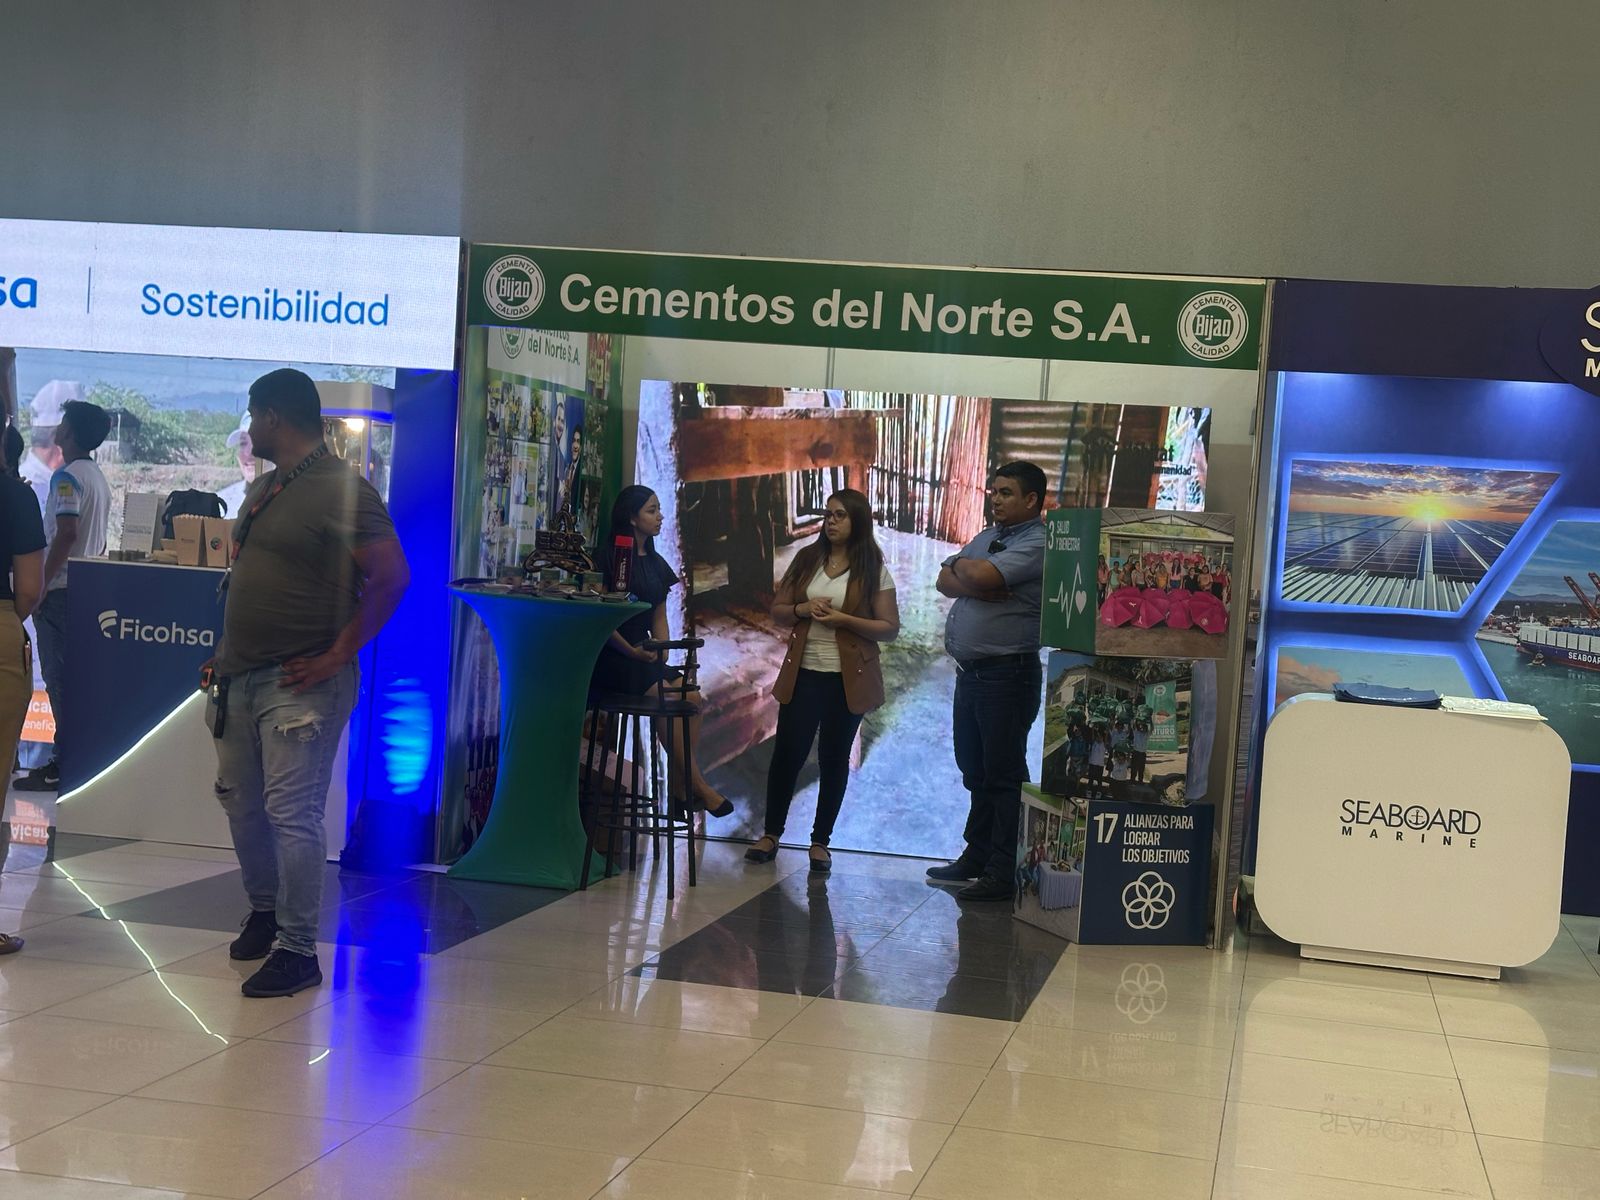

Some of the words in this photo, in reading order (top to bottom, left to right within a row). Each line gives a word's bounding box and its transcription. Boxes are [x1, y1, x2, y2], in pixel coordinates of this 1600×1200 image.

[495, 259, 535, 275] CEMENTO
[499, 276, 530, 301] Bijao
[141, 284, 389, 326] Sostenibilidad
[495, 302, 530, 316] CALIDAD
[560, 273, 795, 325] Cementos
[812, 289, 883, 329] del
[900, 292, 1034, 338] Norte
[1050, 300, 1151, 344] S.A.
[1192, 296, 1238, 312] CEMENTO
[1194, 314, 1231, 340] Bijao
[527, 335, 542, 354] del
[544, 338, 567, 360] Norte
[567, 346, 581, 366] S.A.
[1191, 342, 1230, 356] CALIDAD
[1048, 520, 1055, 550] 3
[120, 618, 214, 647] Ficohsa
[1093, 812, 1119, 844] 17
[1124, 814, 1169, 829] ALIANZAS
[1170, 815, 1194, 830] PARA
[1340, 799, 1481, 835] SEABOARD
[1123, 831, 1160, 846] LOGRAR
[1341, 826, 1477, 848] MARINE
[1122, 848, 1140, 863] LOS
[1141, 849, 1190, 864] OBJETIVOS
